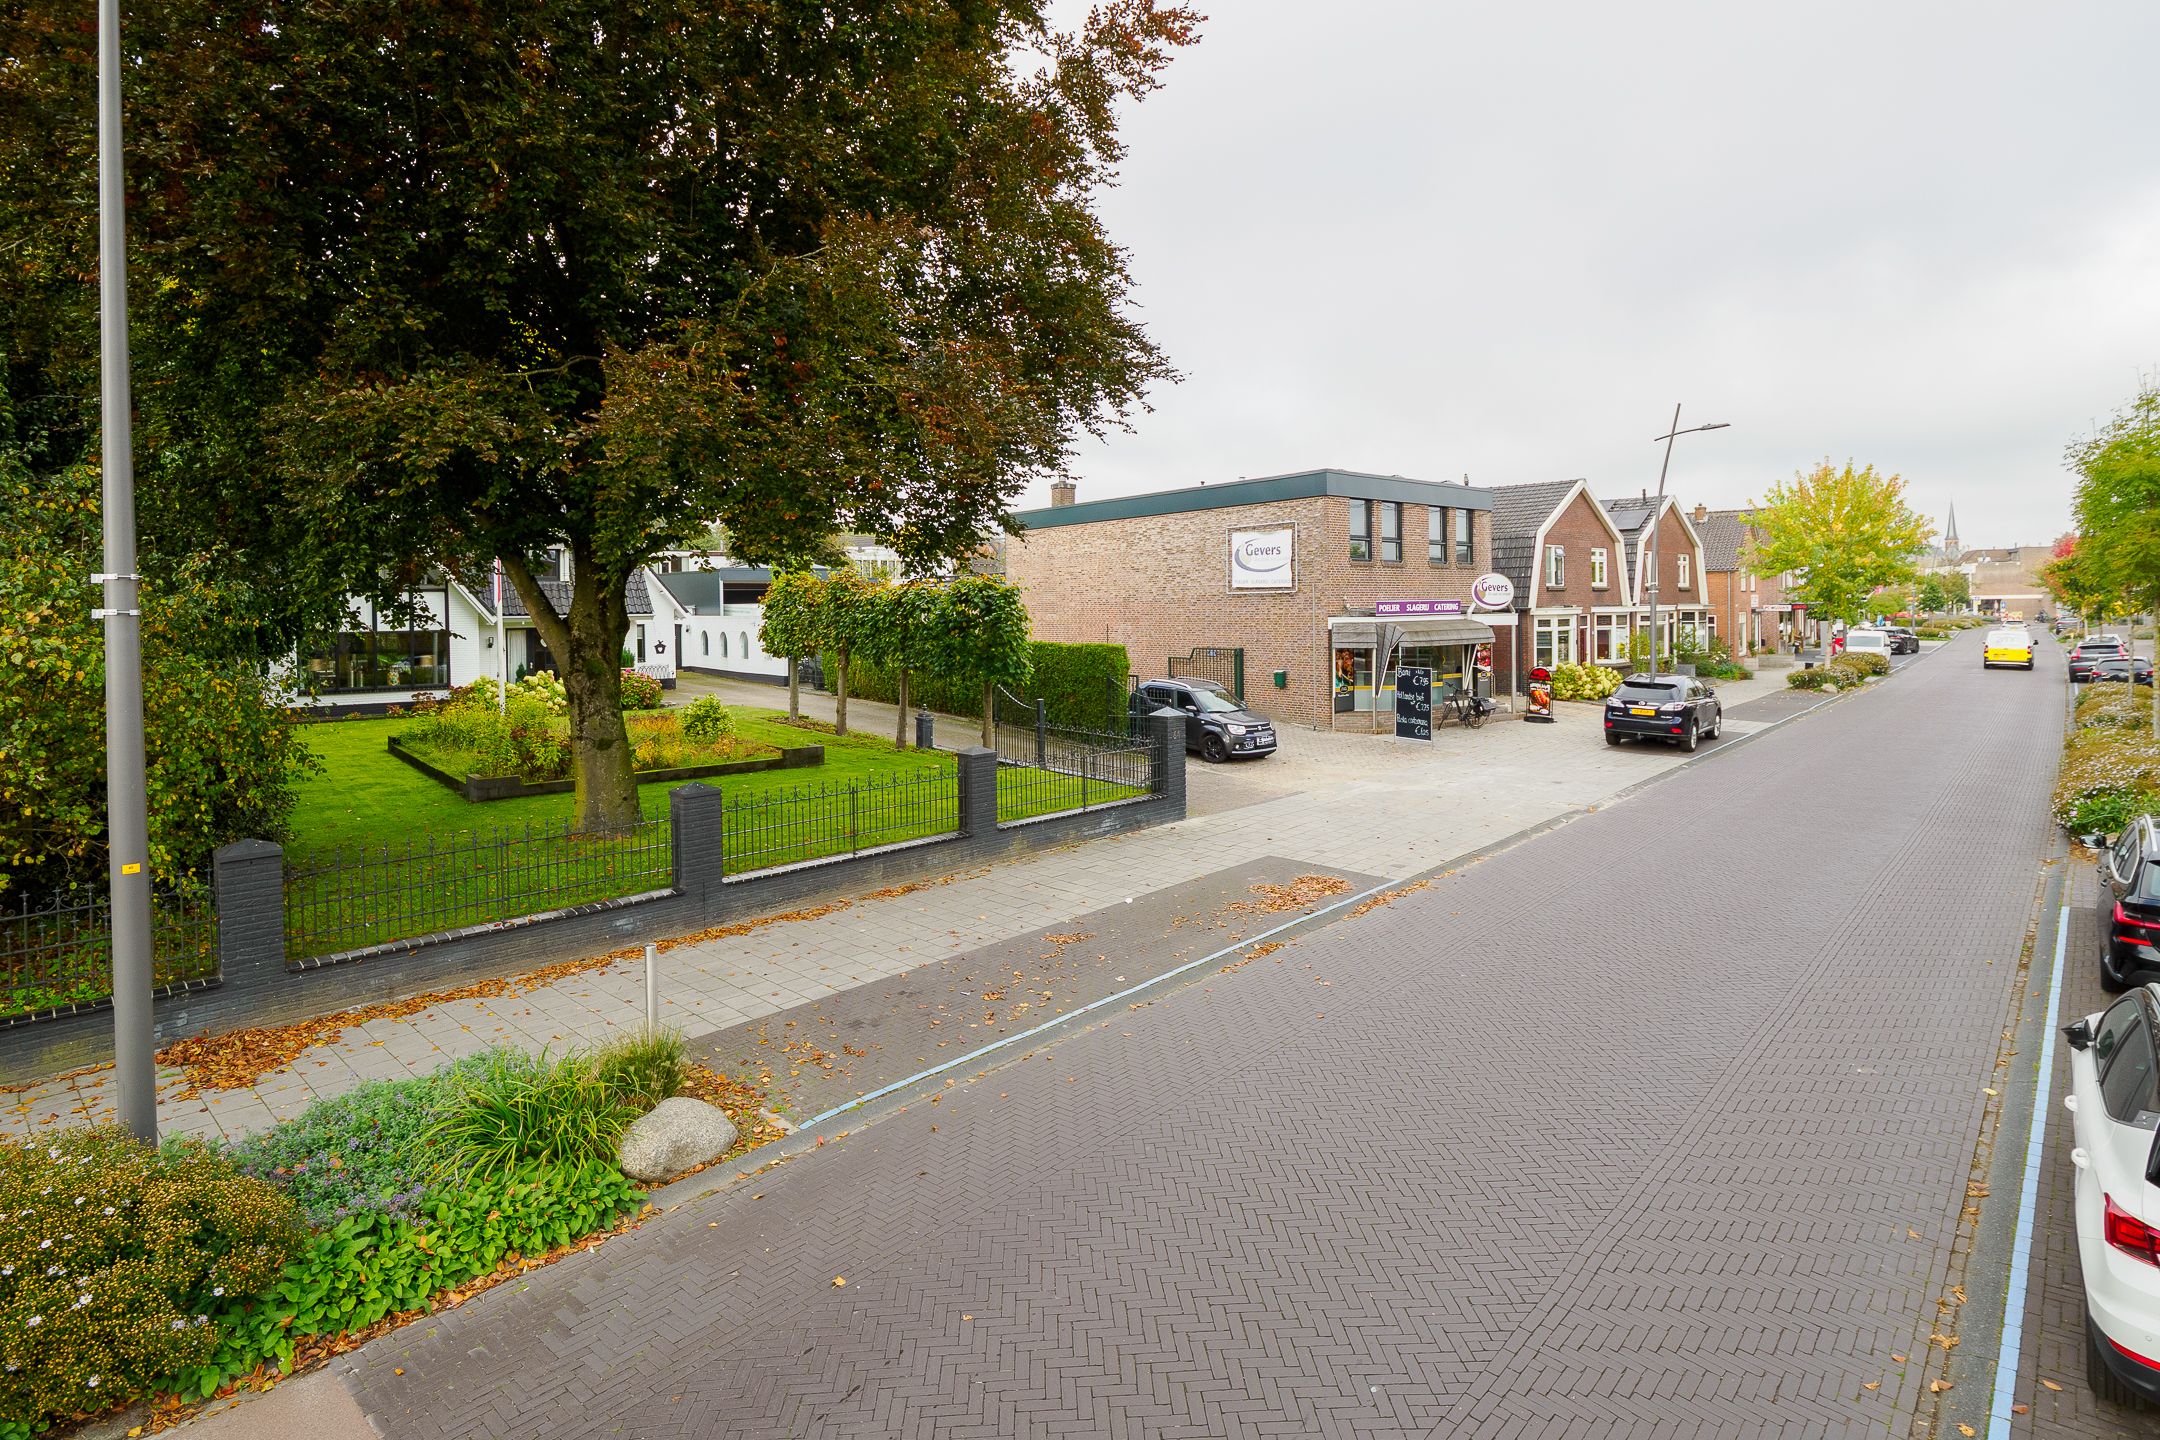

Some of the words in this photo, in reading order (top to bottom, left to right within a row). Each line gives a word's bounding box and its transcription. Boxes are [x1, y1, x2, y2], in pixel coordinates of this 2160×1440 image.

[1245, 543, 1281, 556] Gevers
[1481, 581, 1508, 591] Gevers
[1378, 604, 1400, 612] POELIER
[1434, 602, 1459, 611] CATERING
